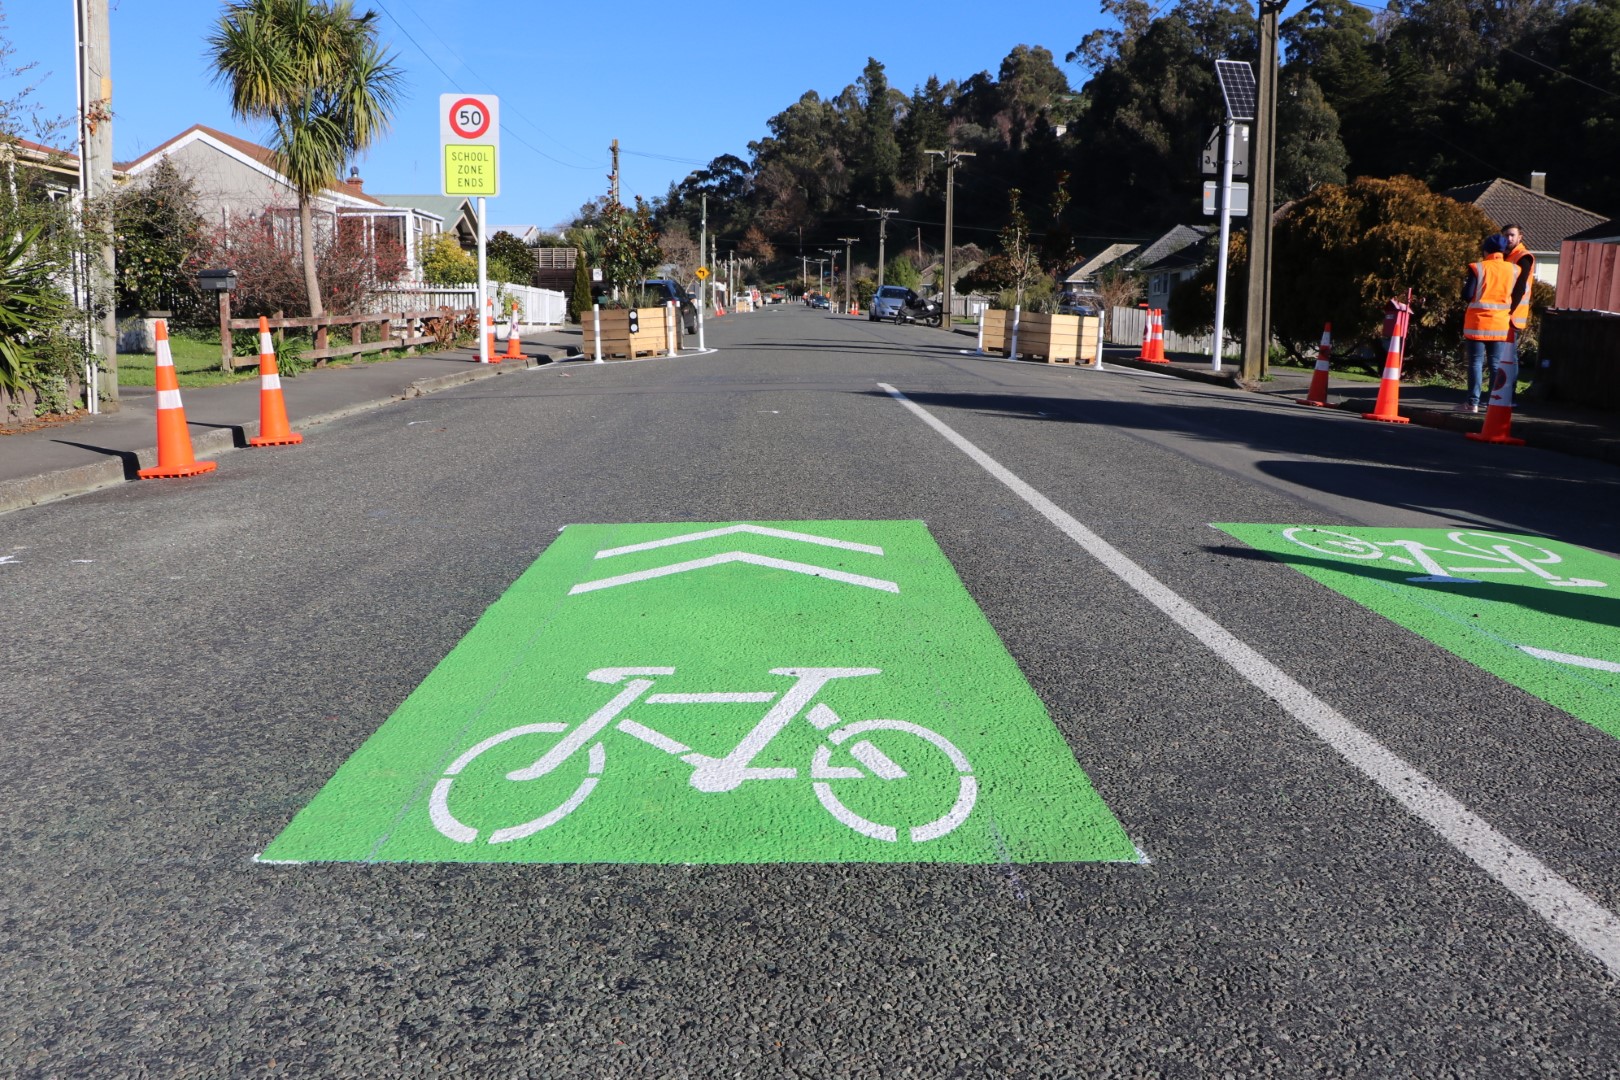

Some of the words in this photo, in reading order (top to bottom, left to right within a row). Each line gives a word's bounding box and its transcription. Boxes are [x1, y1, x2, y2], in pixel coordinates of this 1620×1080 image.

[460, 111, 482, 125] 50
[451, 151, 489, 162] SCHOOL
[457, 164, 483, 174] ZONE
[457, 177, 484, 187] ENDS
